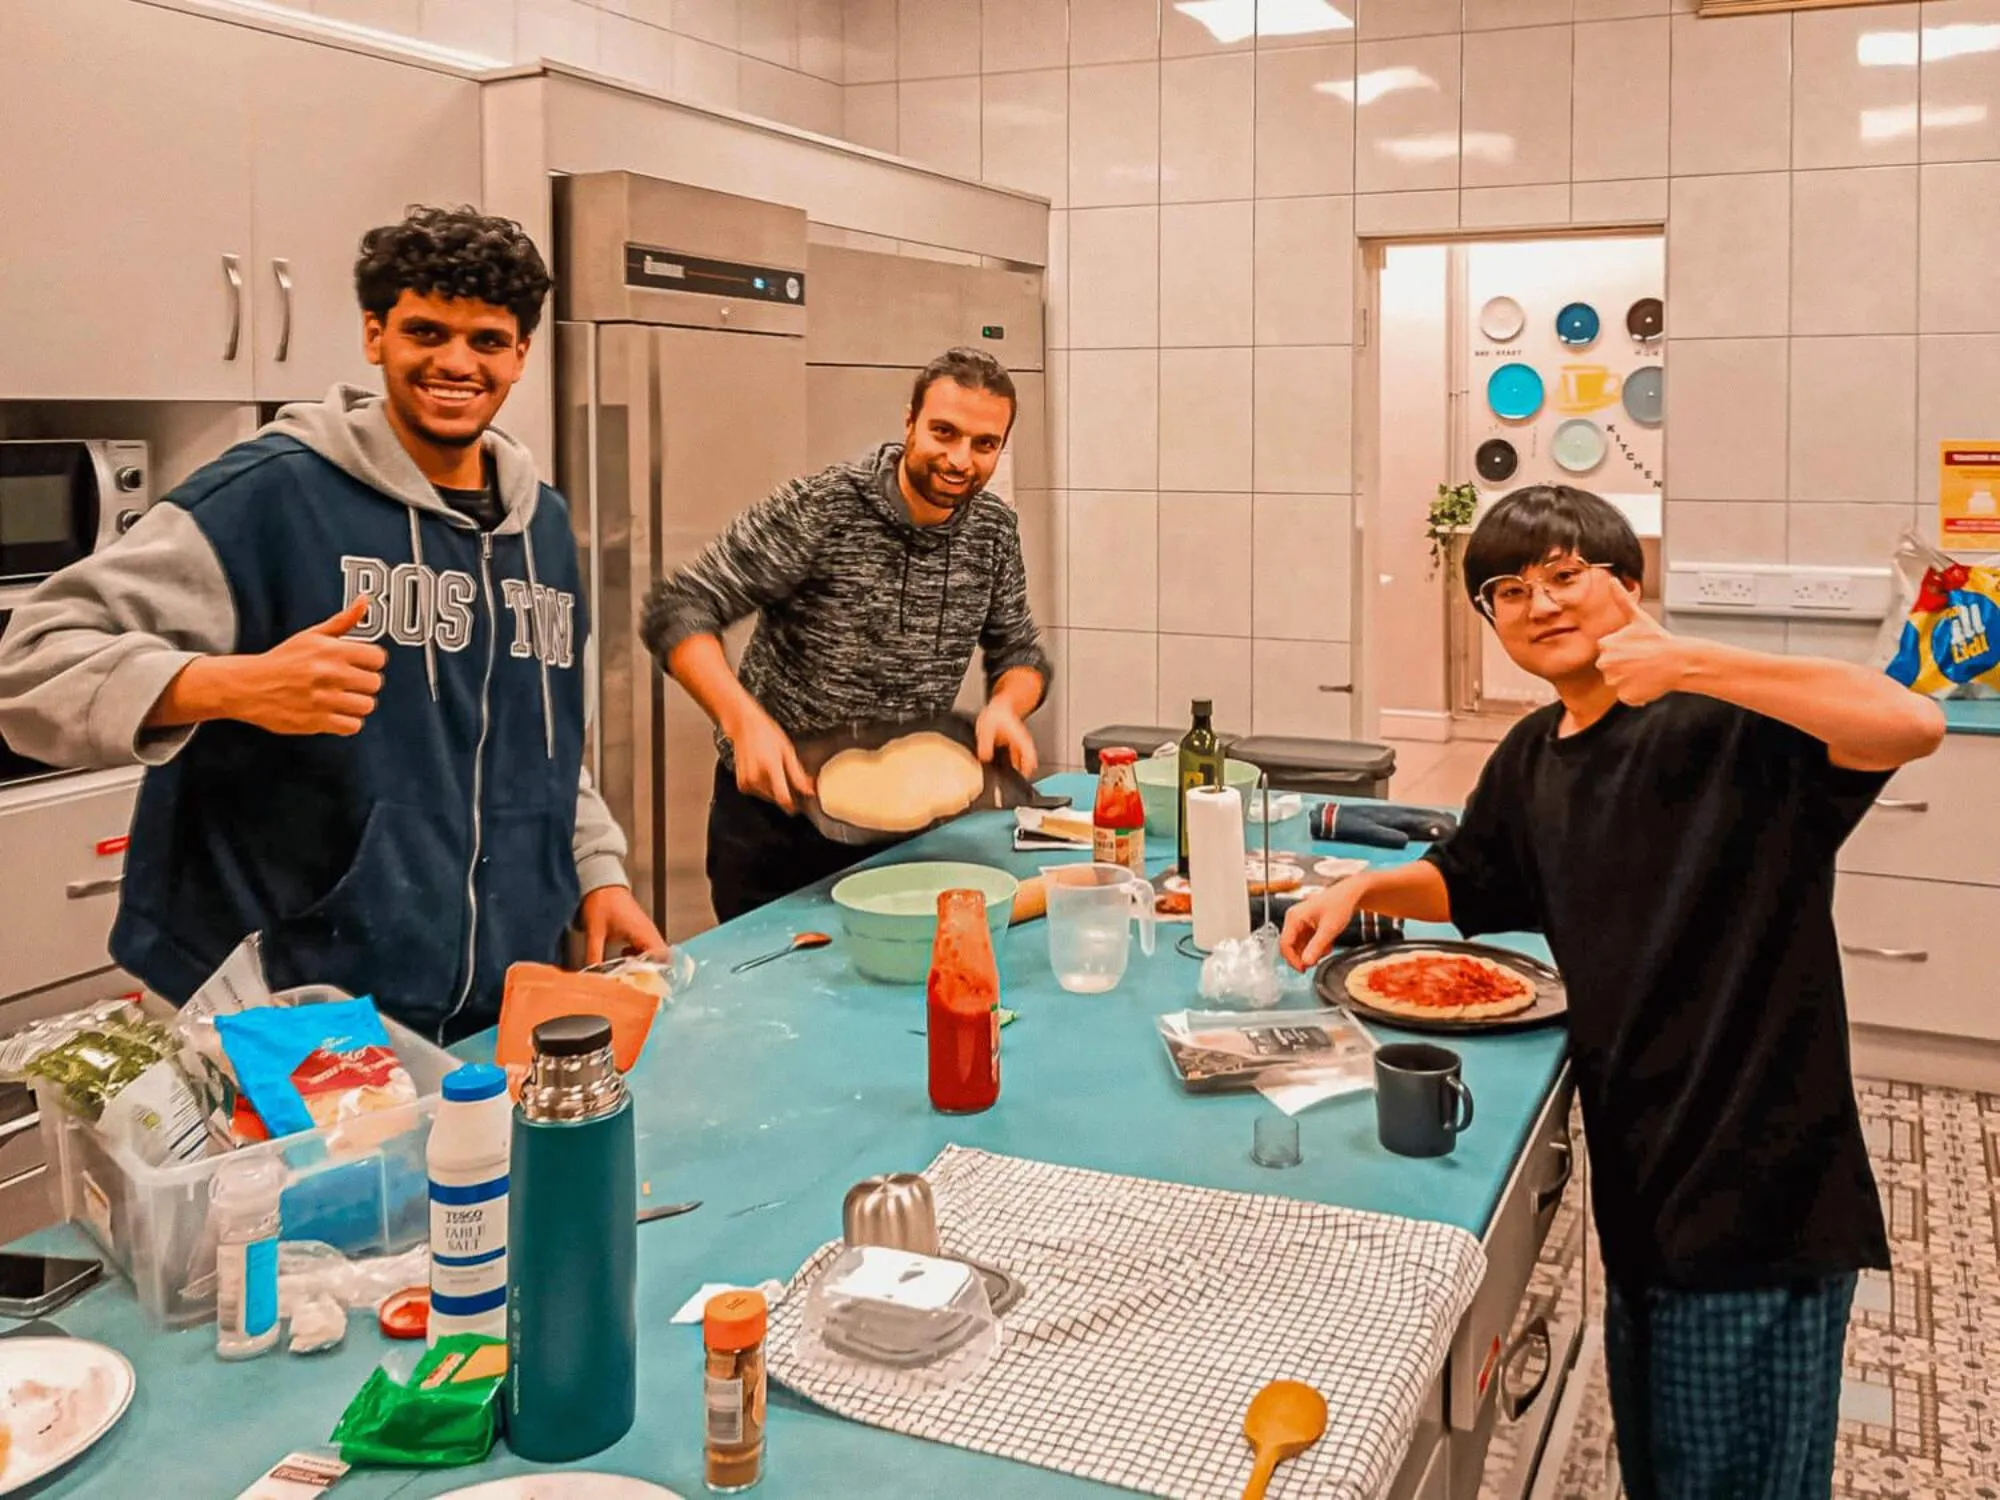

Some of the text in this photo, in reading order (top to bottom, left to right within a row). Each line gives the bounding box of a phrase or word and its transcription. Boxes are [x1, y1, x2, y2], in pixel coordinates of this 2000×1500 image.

[1606, 424, 1662, 489] KITCHEN
[445, 1209, 483, 1224] TESCO
[445, 1223, 486, 1239] TABLE
[447, 1239, 478, 1251] SALT
